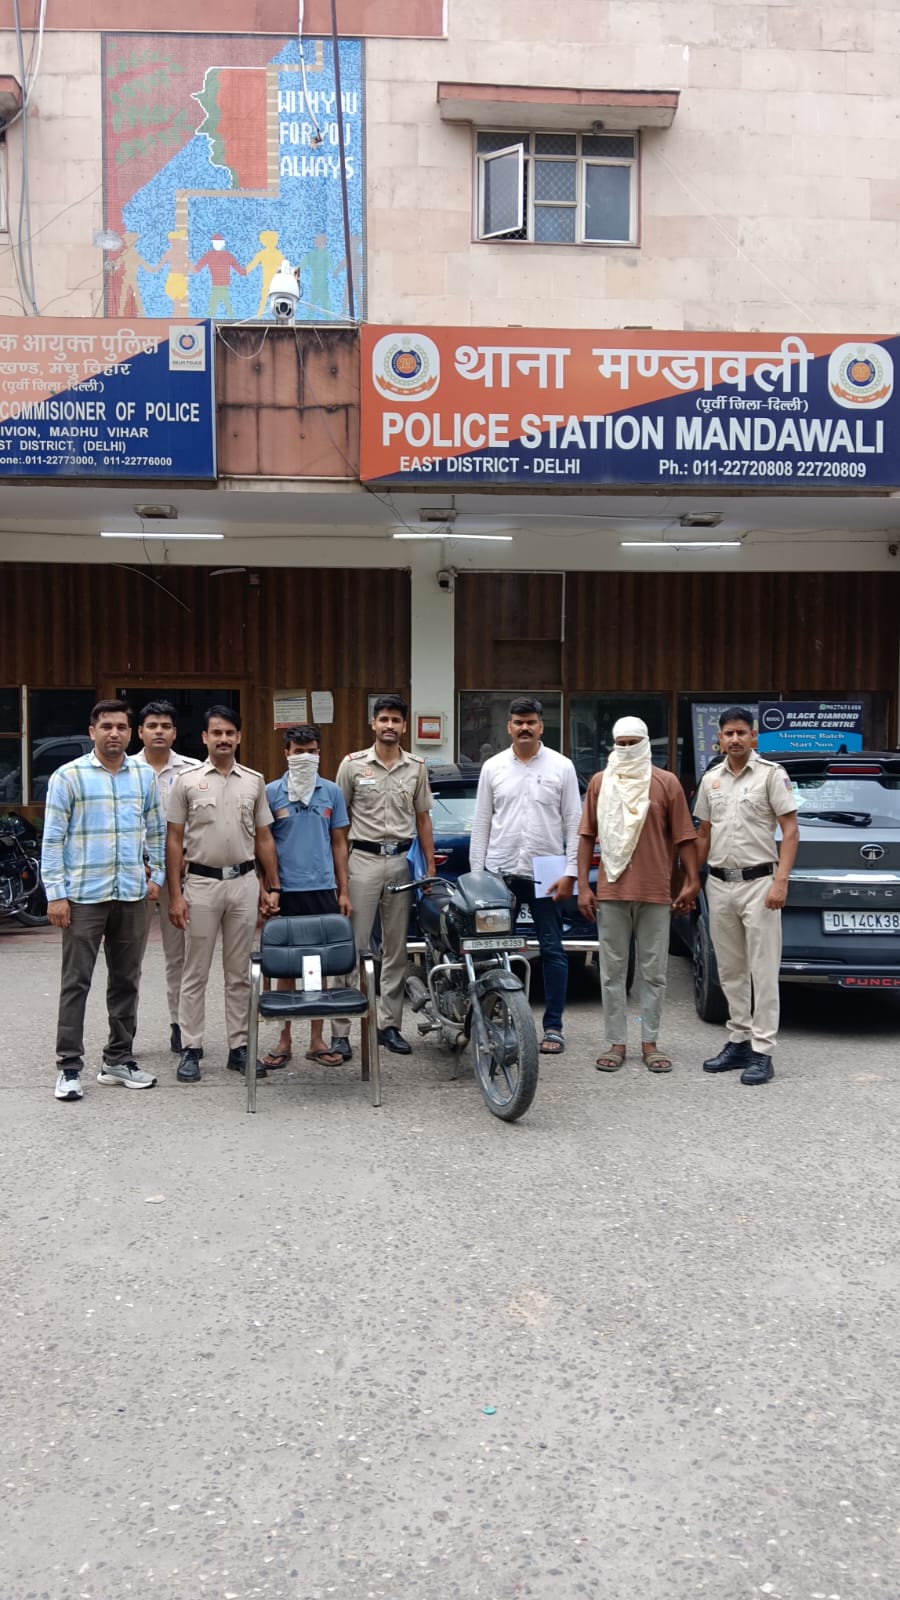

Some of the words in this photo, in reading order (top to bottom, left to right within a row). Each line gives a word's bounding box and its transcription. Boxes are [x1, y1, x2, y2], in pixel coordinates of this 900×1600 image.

[280, 156, 354, 179] ALWAYS
[23, 334, 97, 361] आयुक्त
[101, 328, 162, 362] पुलिस
[83, 359, 132, 376] विहार
[454, 345, 571, 389] थाना
[592, 336, 815, 393] मण्डावली
[0, 401, 107, 420] COMMISIONER
[116, 401, 136, 420] OF
[146, 402, 200, 422] POLICE
[696, 395, 728, 414] (पूर्वी
[50, 427, 98, 437] MADHU
[107, 427, 149, 438] VIHAR
[382, 412, 510, 448] POLICE
[520, 414, 664, 450] STATION
[676, 416, 884, 454] MANDAWALI
[20, 440, 76, 452] DISTRICT,
[83, 441, 126, 454] (DELHI)
[103, 456, 172, 466] 011-22776000
[400, 456, 442, 472] EAST
[446, 456, 519, 473] DISTRICT
[533, 458, 580, 474] DELHI
[659, 460, 688, 476] Ph.:
[692, 460, 793, 476] 011-22720808
[797, 462, 867, 478] 22720809
[833, 889, 894, 897] PUNC
